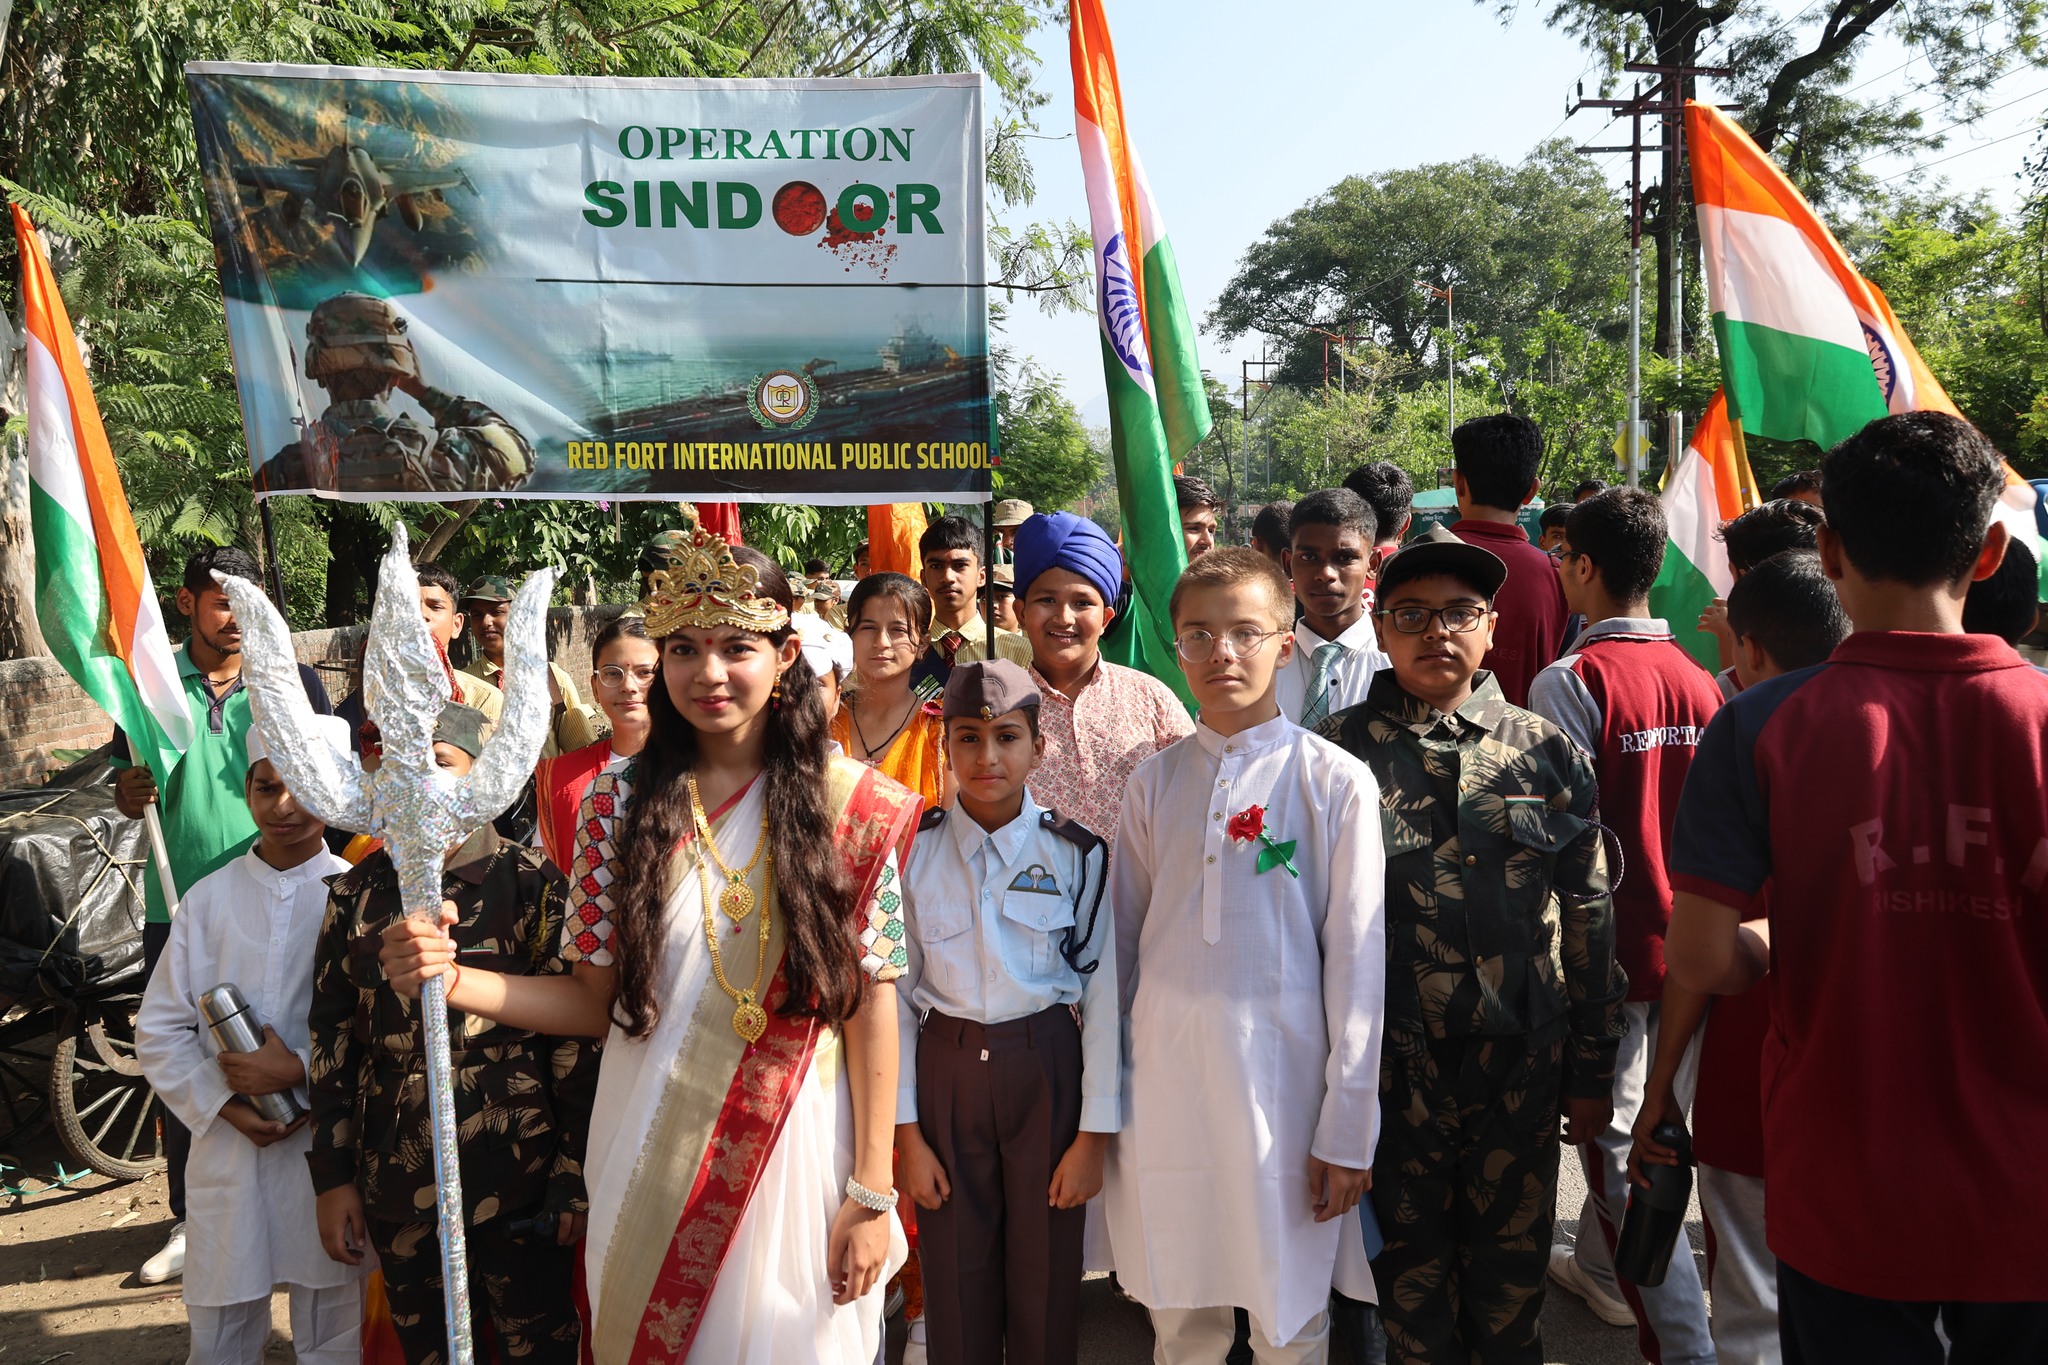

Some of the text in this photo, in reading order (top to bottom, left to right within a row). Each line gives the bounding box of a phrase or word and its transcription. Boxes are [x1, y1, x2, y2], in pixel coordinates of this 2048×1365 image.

[617, 124, 916, 162] OPERATION
[582, 179, 945, 236] SINDOOR
[567, 441, 992, 470] RED FORT INTERNATIONAL PUBLIC SCHOOL
